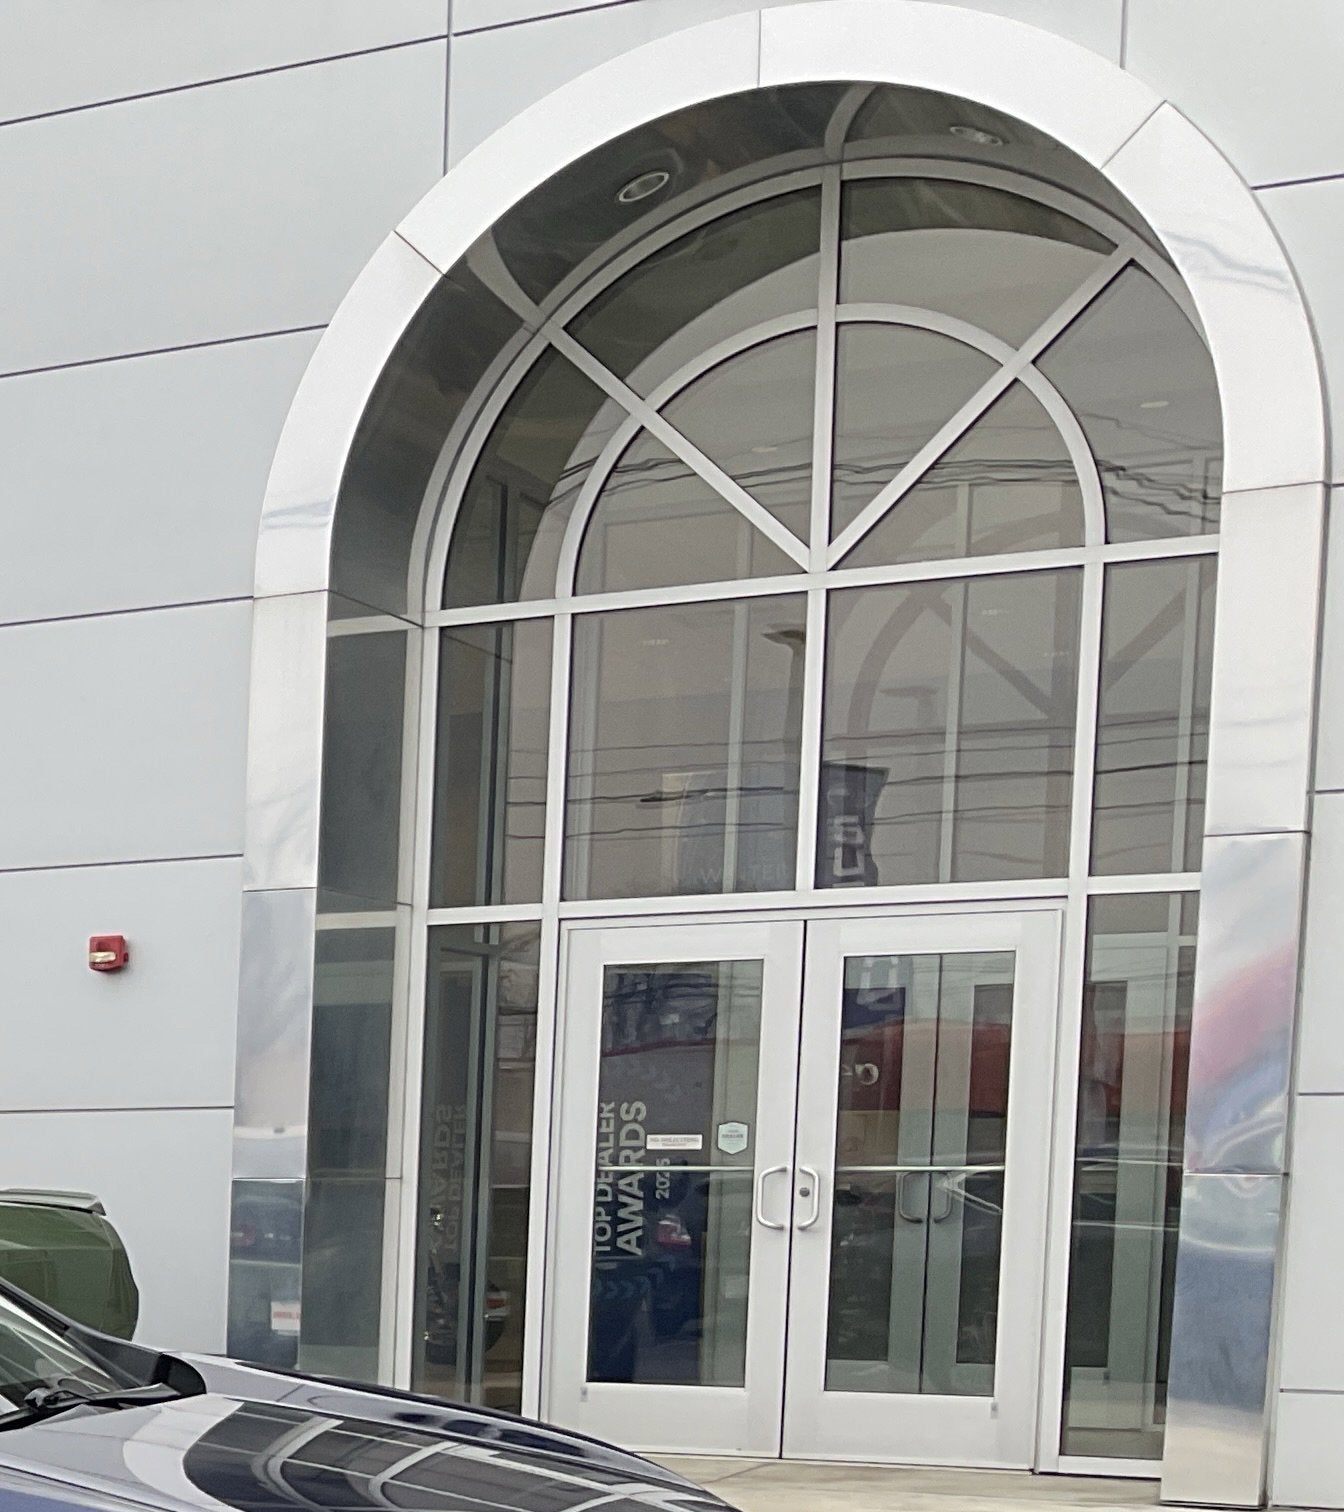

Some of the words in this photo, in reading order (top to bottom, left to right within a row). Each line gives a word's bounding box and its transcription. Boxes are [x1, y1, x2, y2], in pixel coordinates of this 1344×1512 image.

[596, 1101, 616, 1202] DEALER
[616, 1100, 647, 1256] AWARDS
[594, 1206, 612, 1256] TOP
